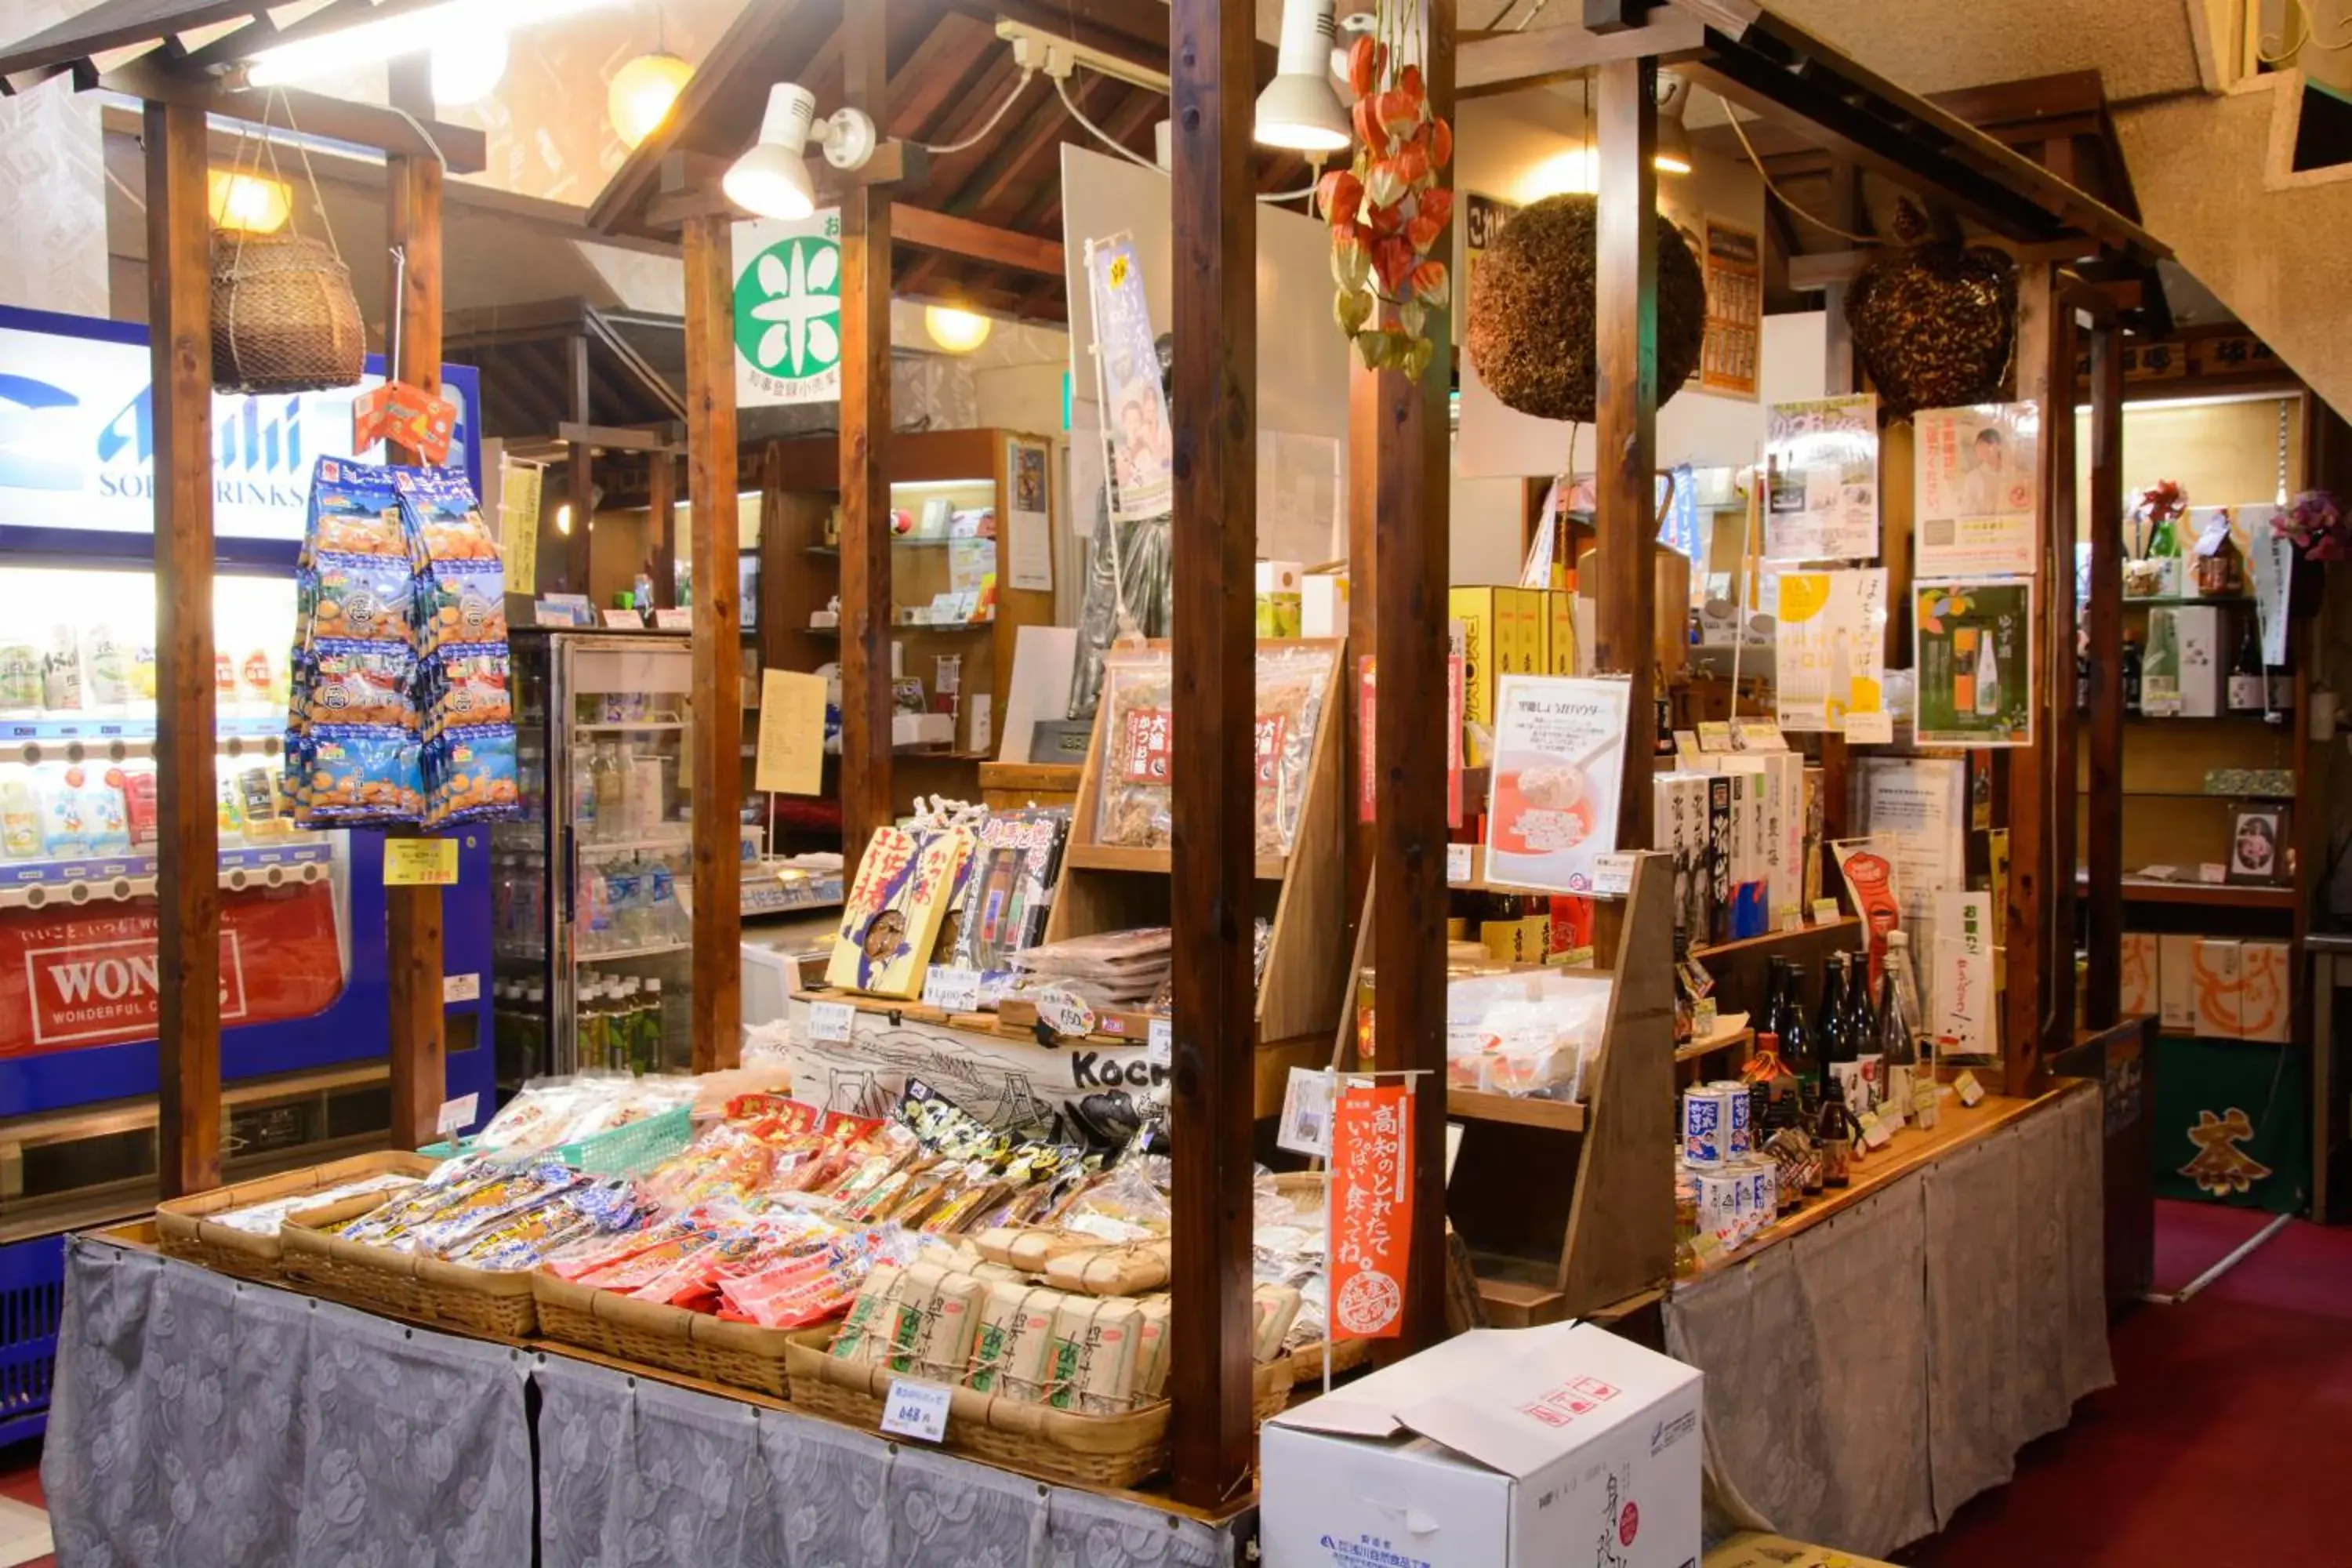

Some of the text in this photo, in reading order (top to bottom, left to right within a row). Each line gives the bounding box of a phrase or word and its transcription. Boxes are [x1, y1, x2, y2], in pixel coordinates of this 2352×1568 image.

[216, 479, 305, 509] RINKS
[52, 1001, 143, 1025] WONDERFUL
[1365, 1104, 1399, 1256] 高知のとれたて
